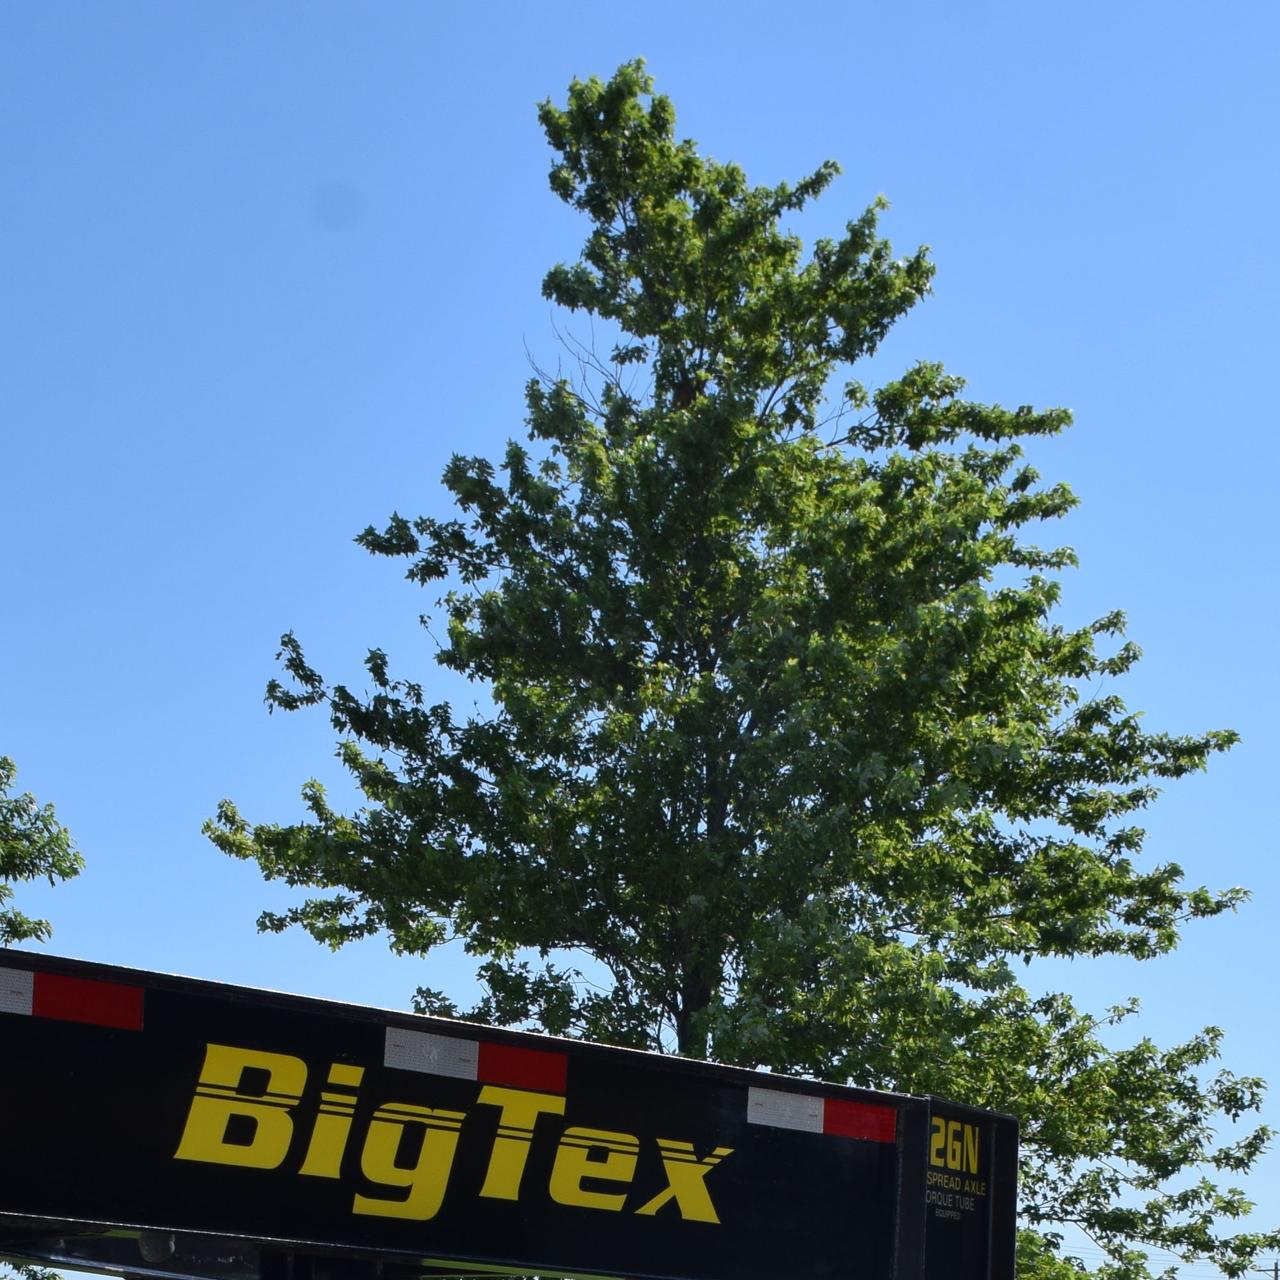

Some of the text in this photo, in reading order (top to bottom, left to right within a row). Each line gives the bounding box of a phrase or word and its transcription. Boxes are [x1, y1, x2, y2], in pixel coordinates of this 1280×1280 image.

[927, 1171, 986, 1196] SPREAD AXLE
[926, 1189, 975, 1212] ORQUE TUBE
